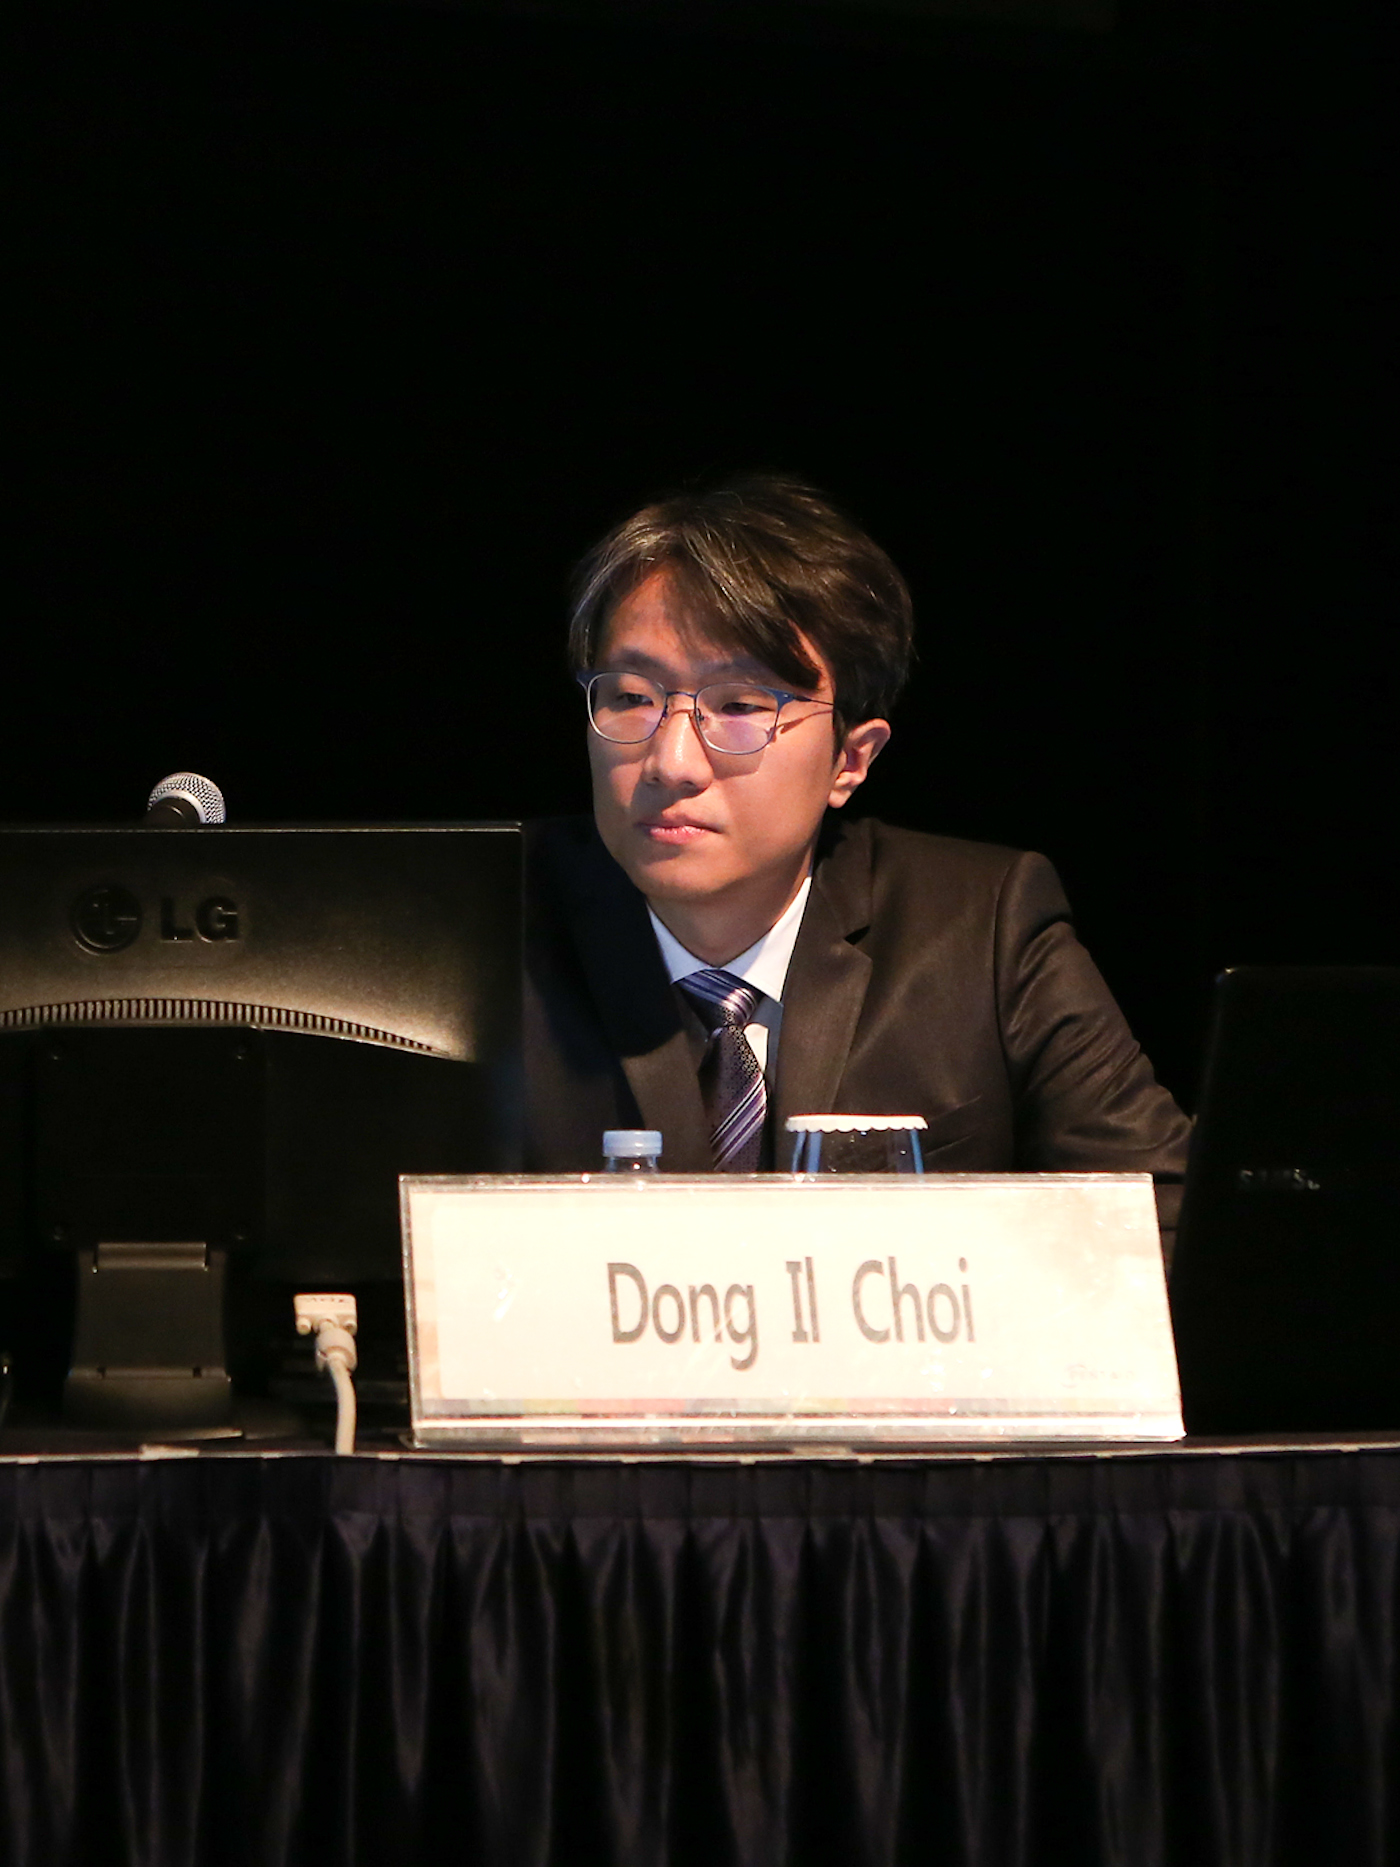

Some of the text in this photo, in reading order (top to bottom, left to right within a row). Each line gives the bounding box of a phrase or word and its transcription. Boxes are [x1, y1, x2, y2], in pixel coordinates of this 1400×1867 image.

[159, 896, 239, 942] LG
[607, 1256, 976, 1371] Dong Il Choi
